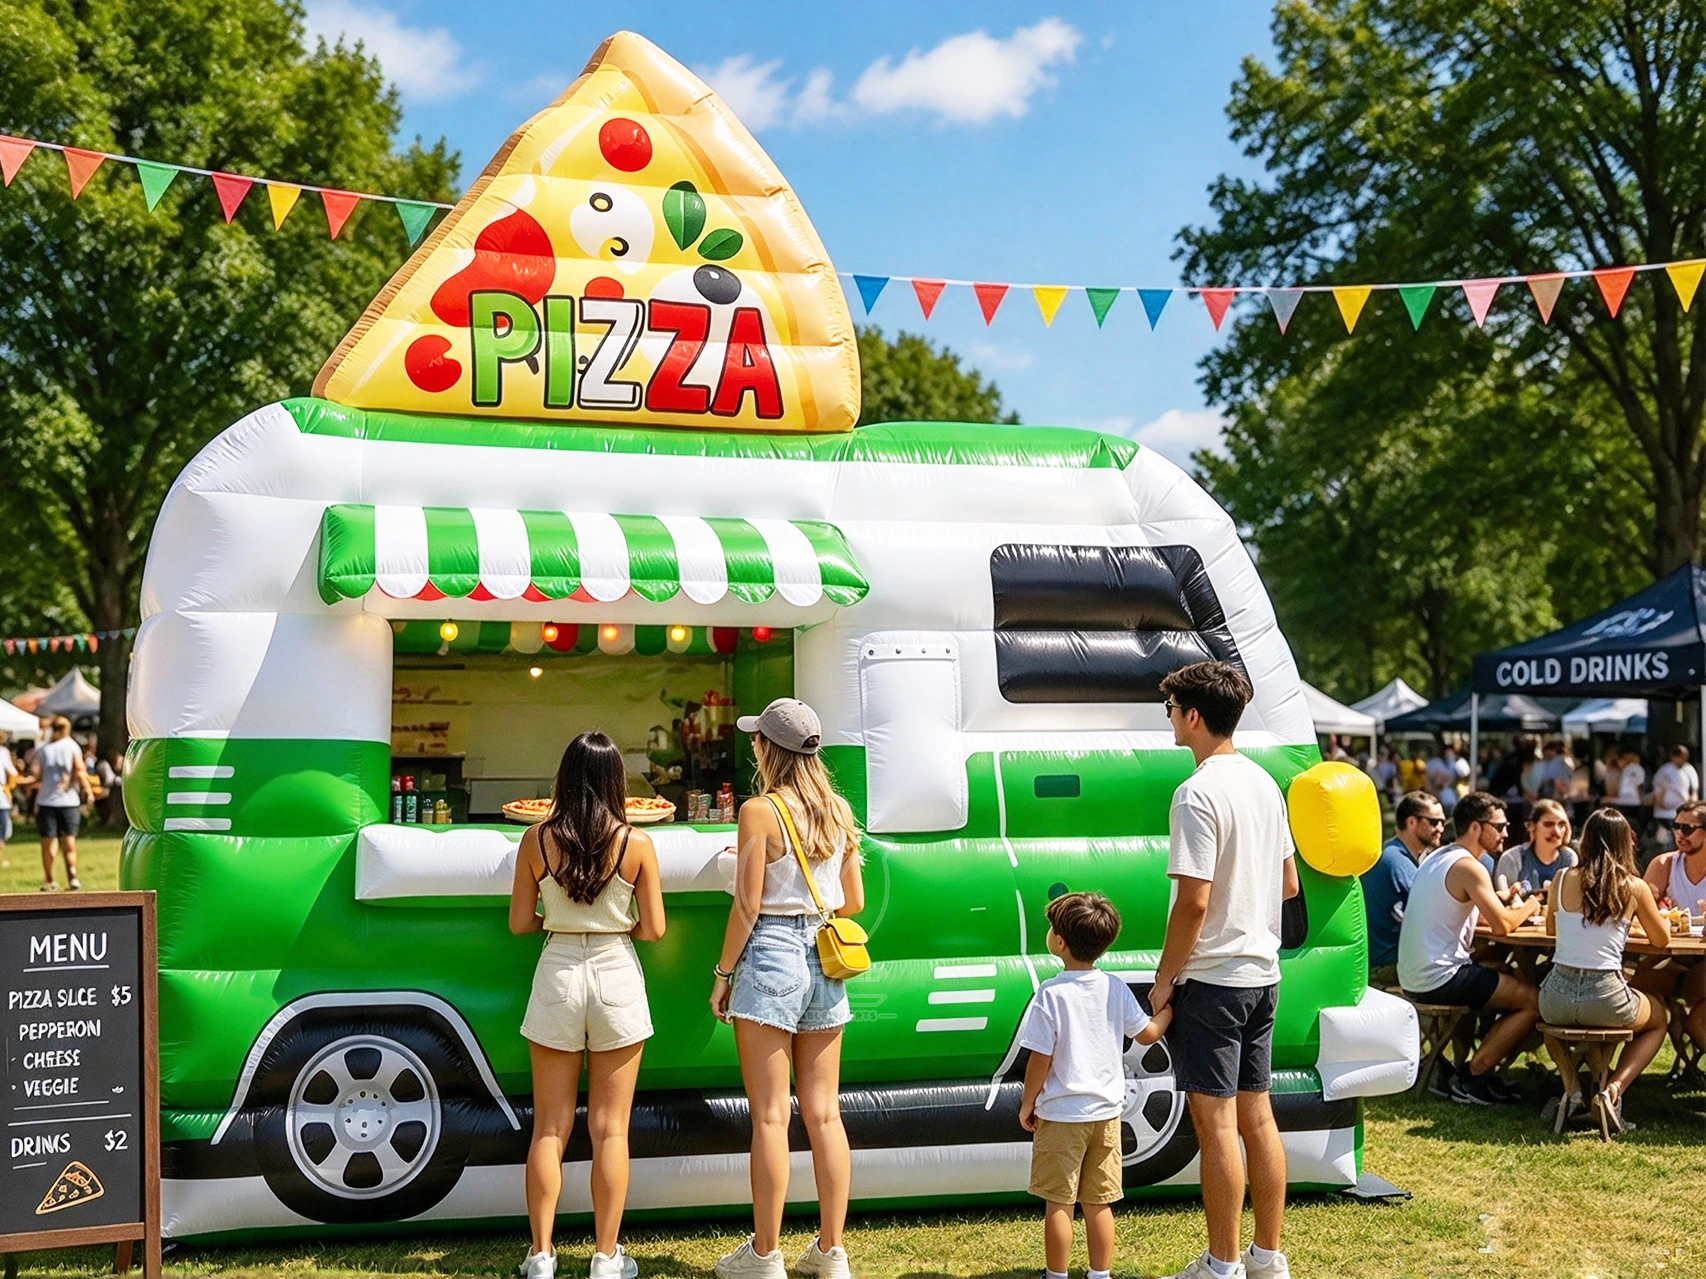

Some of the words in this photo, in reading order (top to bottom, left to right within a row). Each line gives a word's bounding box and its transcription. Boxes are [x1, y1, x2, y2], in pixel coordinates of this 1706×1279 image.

[469, 290, 784, 419] PIZZA
[1496, 658, 1562, 687] COLD
[1570, 651, 1670, 684] DRINKS
[29, 932, 107, 963] MENU
[8, 989, 53, 1010] PIZZA
[111, 984, 132, 1007] $5
[23, 1049, 81, 1069] CHEESE
[104, 1130, 128, 1152] $2
